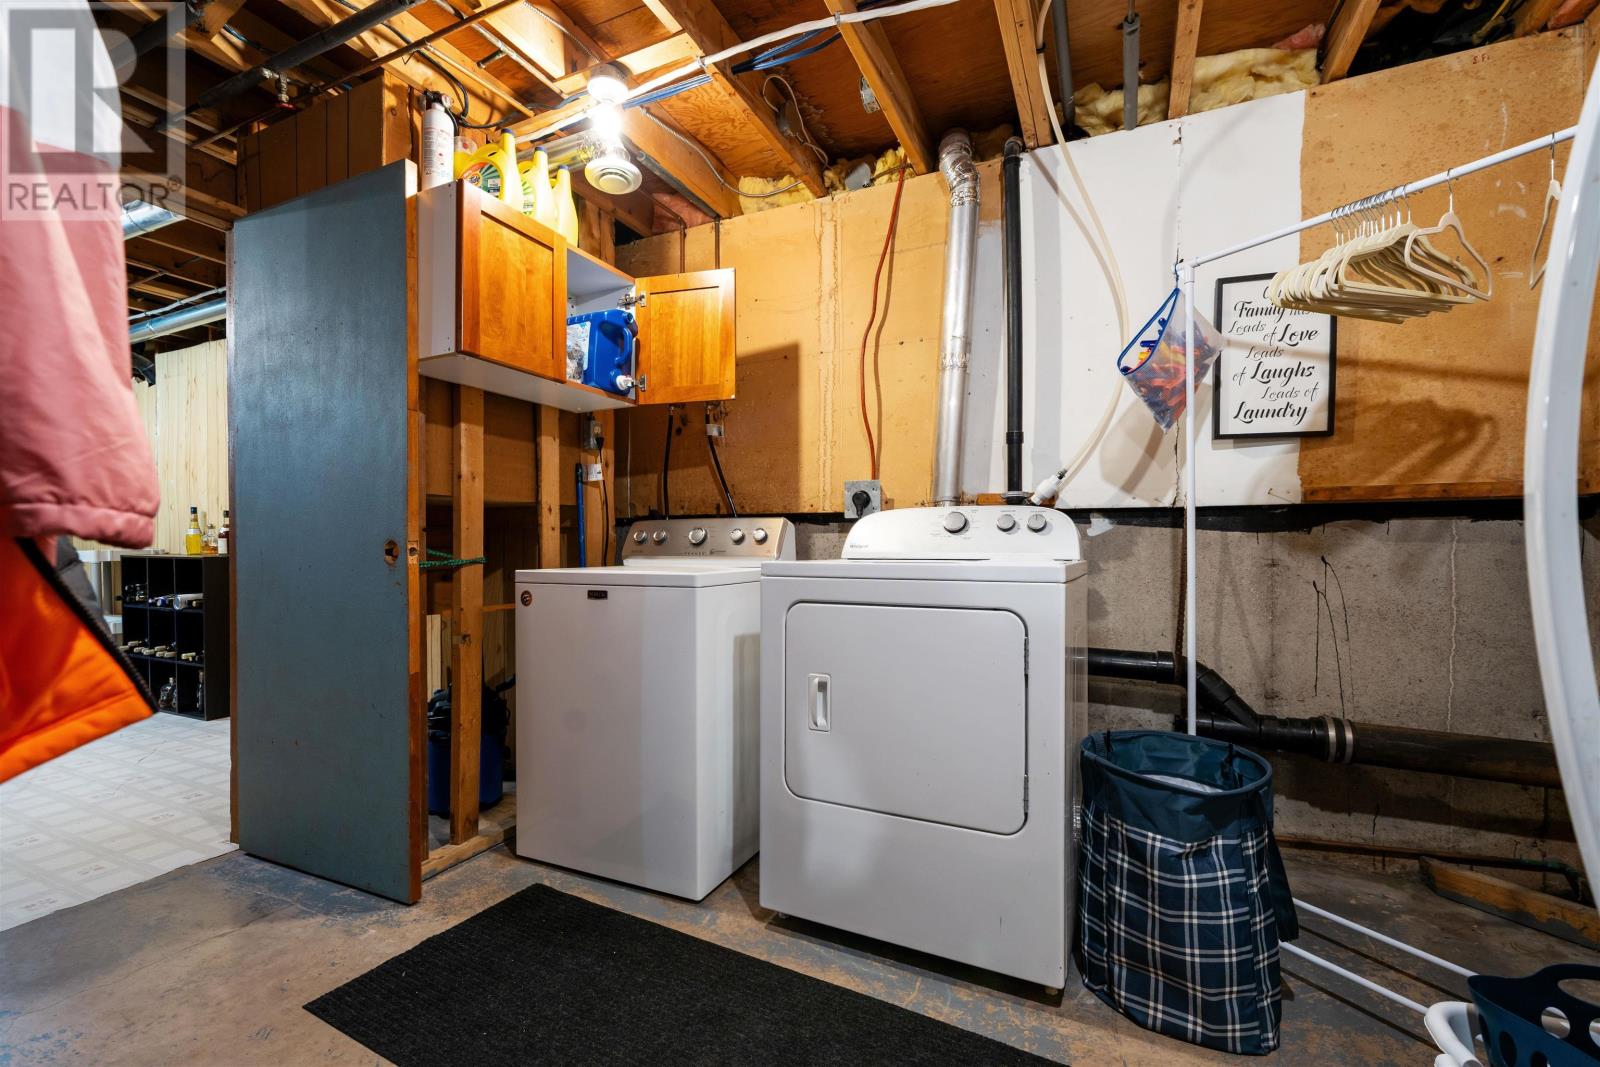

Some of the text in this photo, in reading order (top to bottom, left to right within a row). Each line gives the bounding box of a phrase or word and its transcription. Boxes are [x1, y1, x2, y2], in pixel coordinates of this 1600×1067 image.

[1233, 300, 1286, 323] Family
[1228, 320, 1267, 336] Loads
[1263, 324, 1319, 347] of Love
[1245, 346, 1285, 361] Loads
[1232, 361, 1315, 387] of Laughs
[1261, 382, 1319, 401] Loads of
[1233, 401, 1308, 426] Laundry
